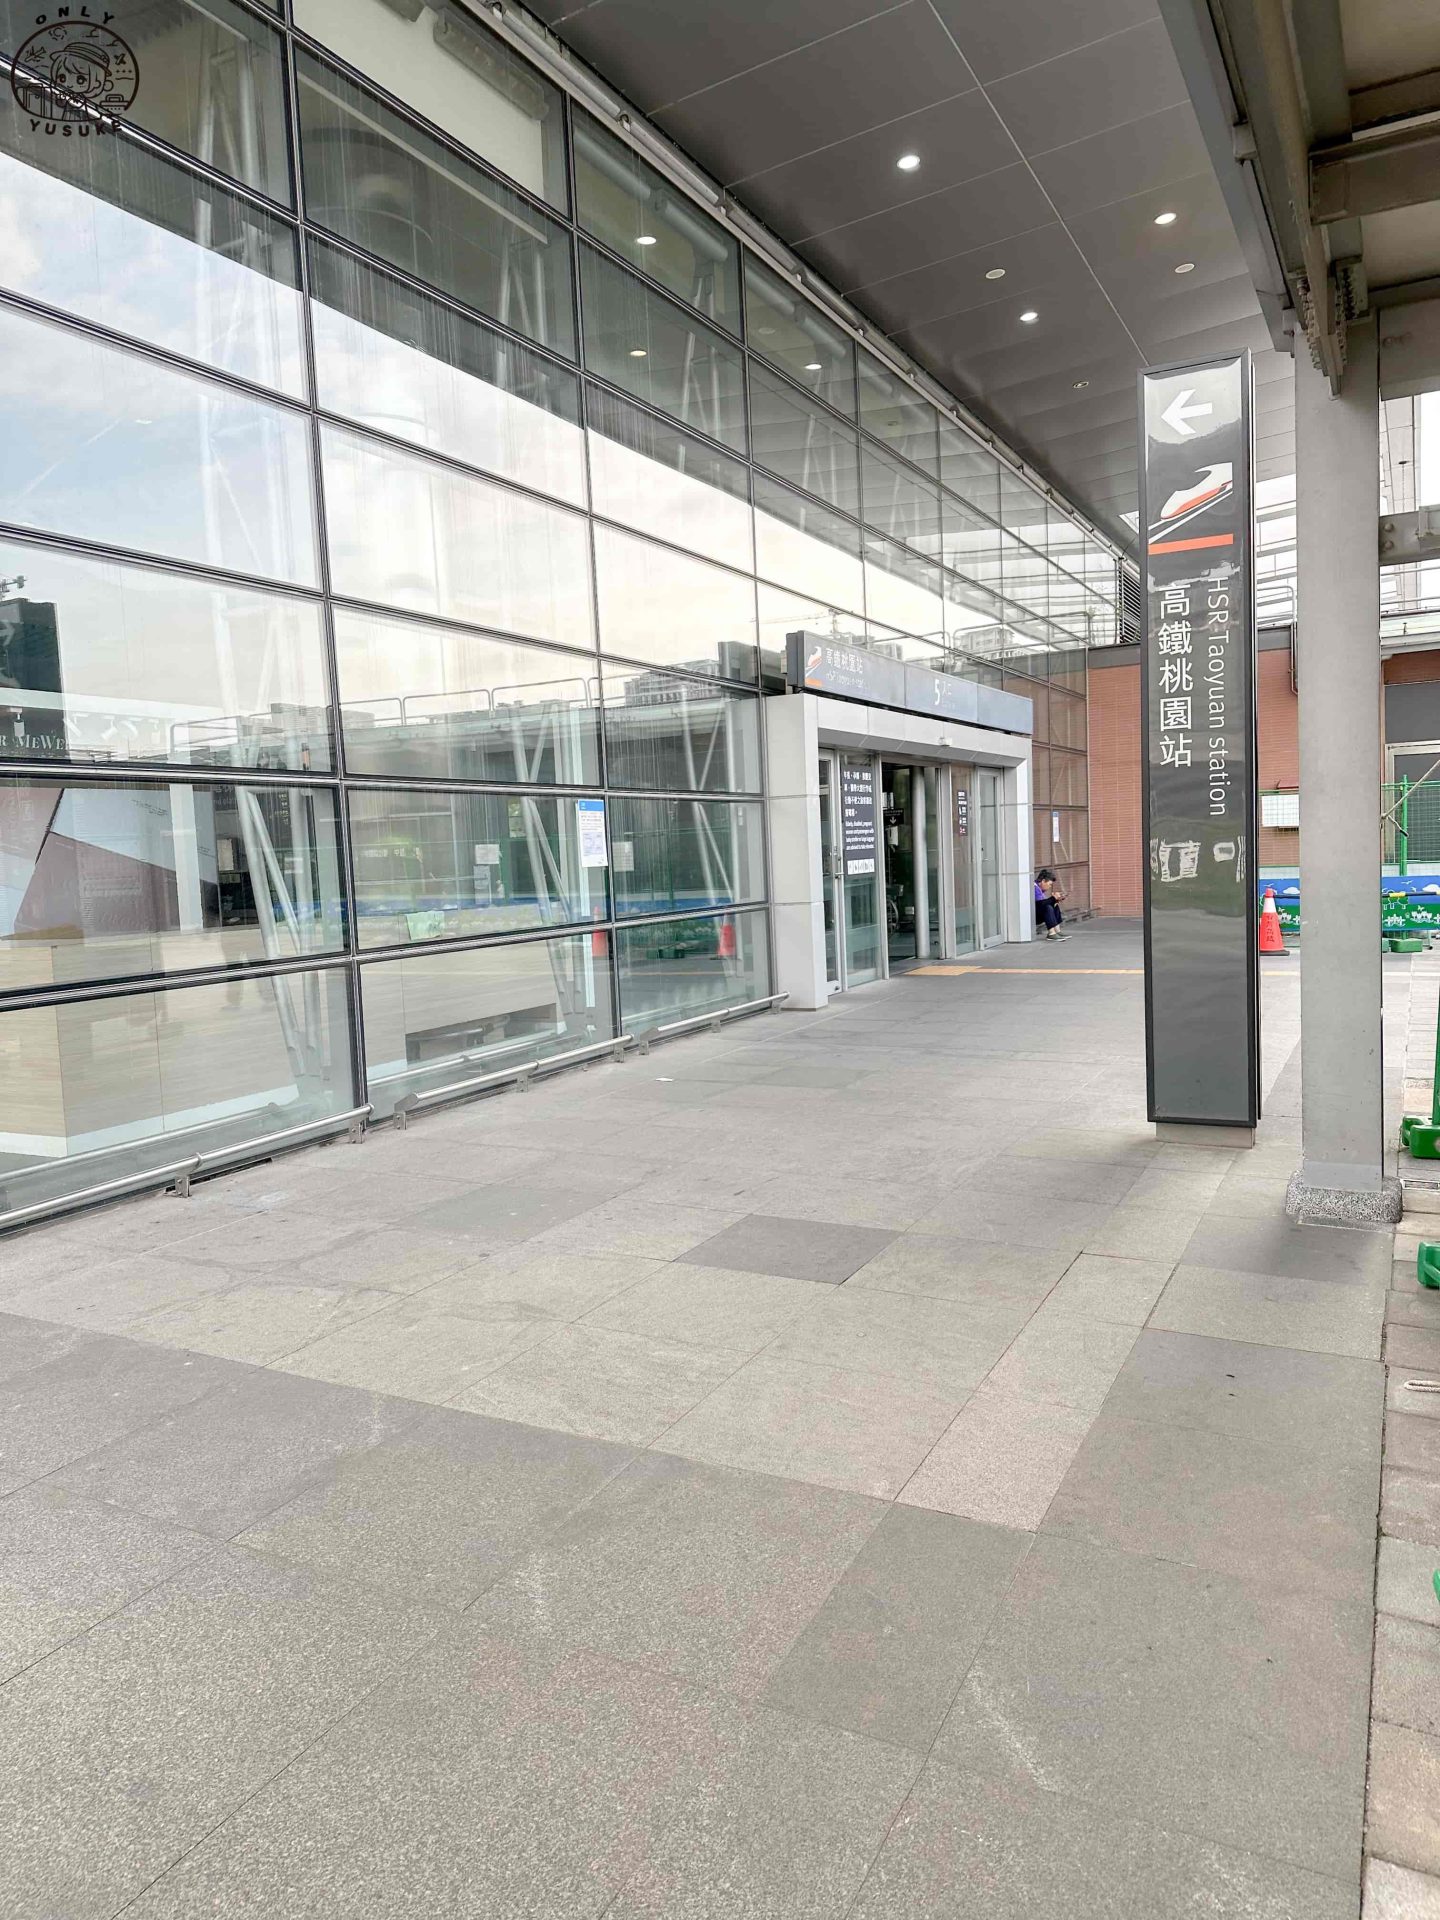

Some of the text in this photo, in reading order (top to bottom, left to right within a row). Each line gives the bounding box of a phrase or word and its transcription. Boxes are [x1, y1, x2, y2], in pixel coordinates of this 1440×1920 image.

[1158, 583, 1194, 768] 高鐵桃園站
[1203, 576, 1232, 816] HSR Taoyuan station
